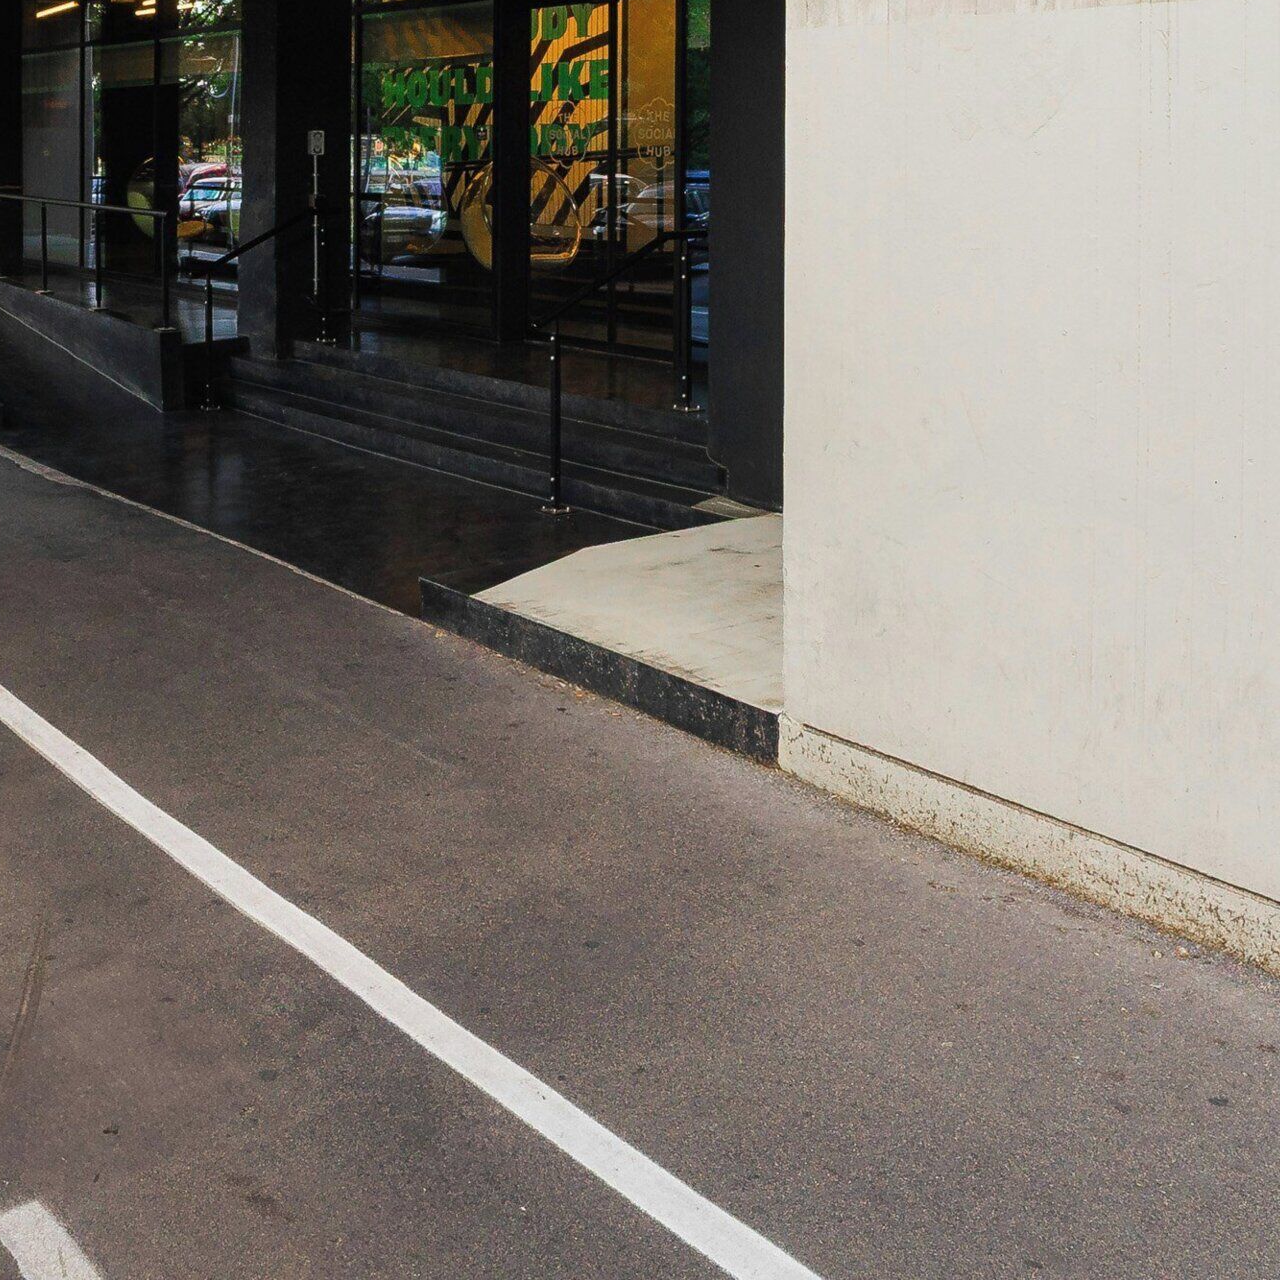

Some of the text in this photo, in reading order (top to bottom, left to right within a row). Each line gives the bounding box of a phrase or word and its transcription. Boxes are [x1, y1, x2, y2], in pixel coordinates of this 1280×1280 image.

[530, 58, 610, 104] IKE
[638, 127, 674, 139] SOCIA
[646, 145, 671, 158] HUB
